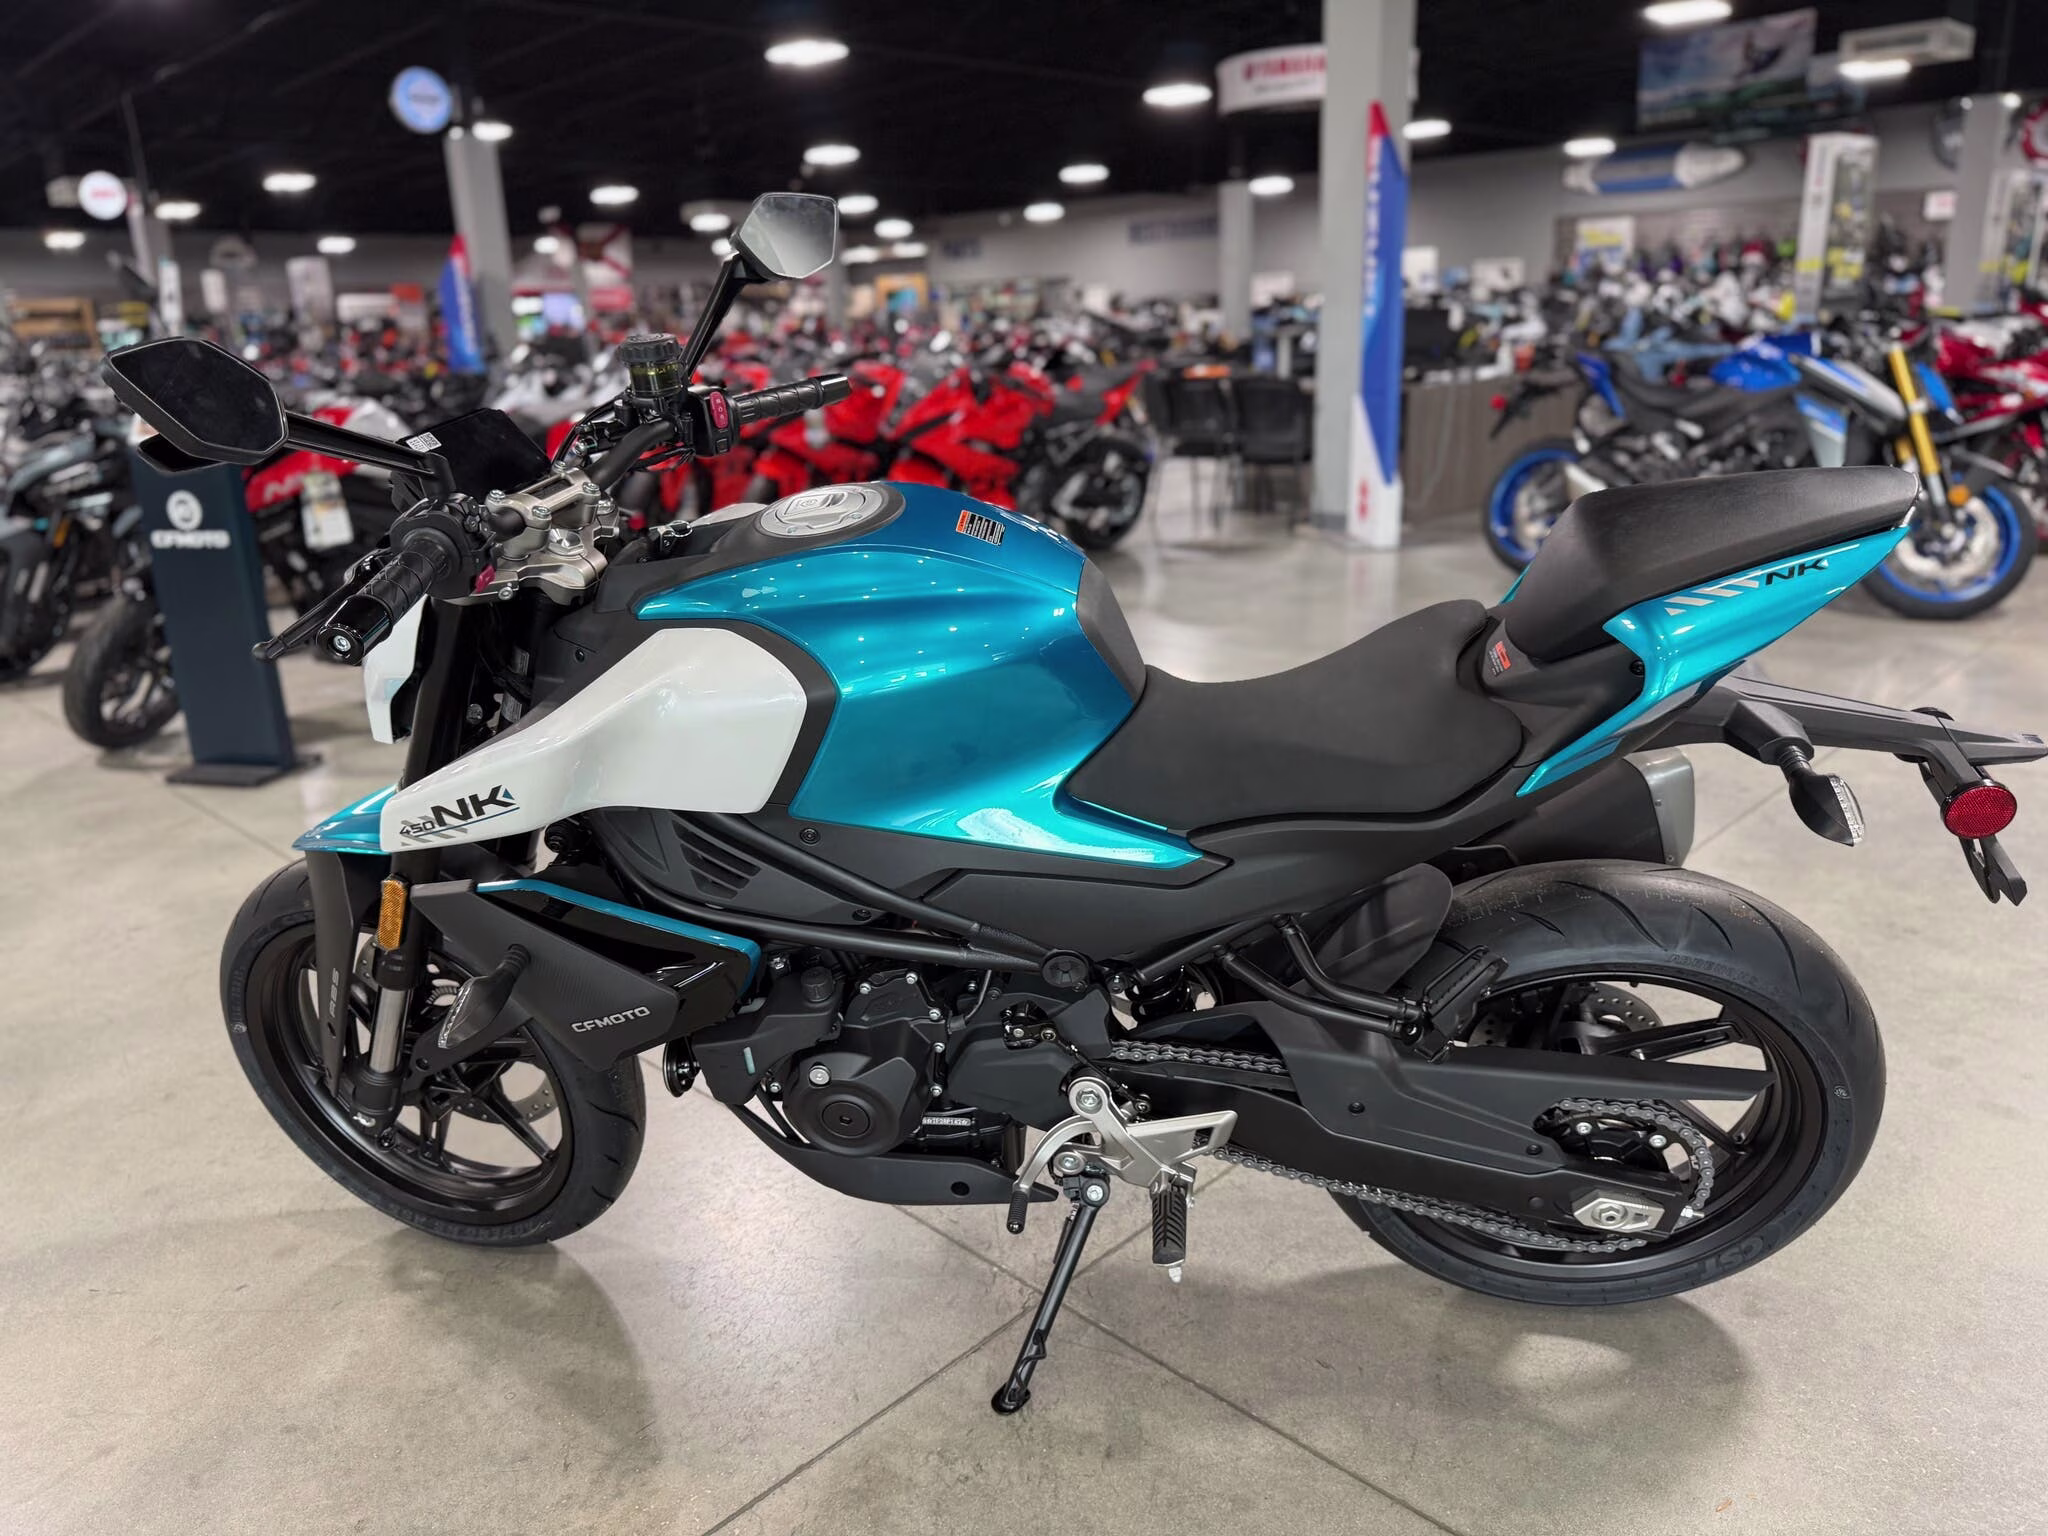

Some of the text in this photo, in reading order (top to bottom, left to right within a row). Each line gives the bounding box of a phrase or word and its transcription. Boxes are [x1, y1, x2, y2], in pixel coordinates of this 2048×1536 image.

[1765, 558, 1828, 585] NK
[399, 784, 516, 835] 450 NK
[329, 967, 340, 1018] ABS
[571, 1006, 651, 1033] CFMOTO
